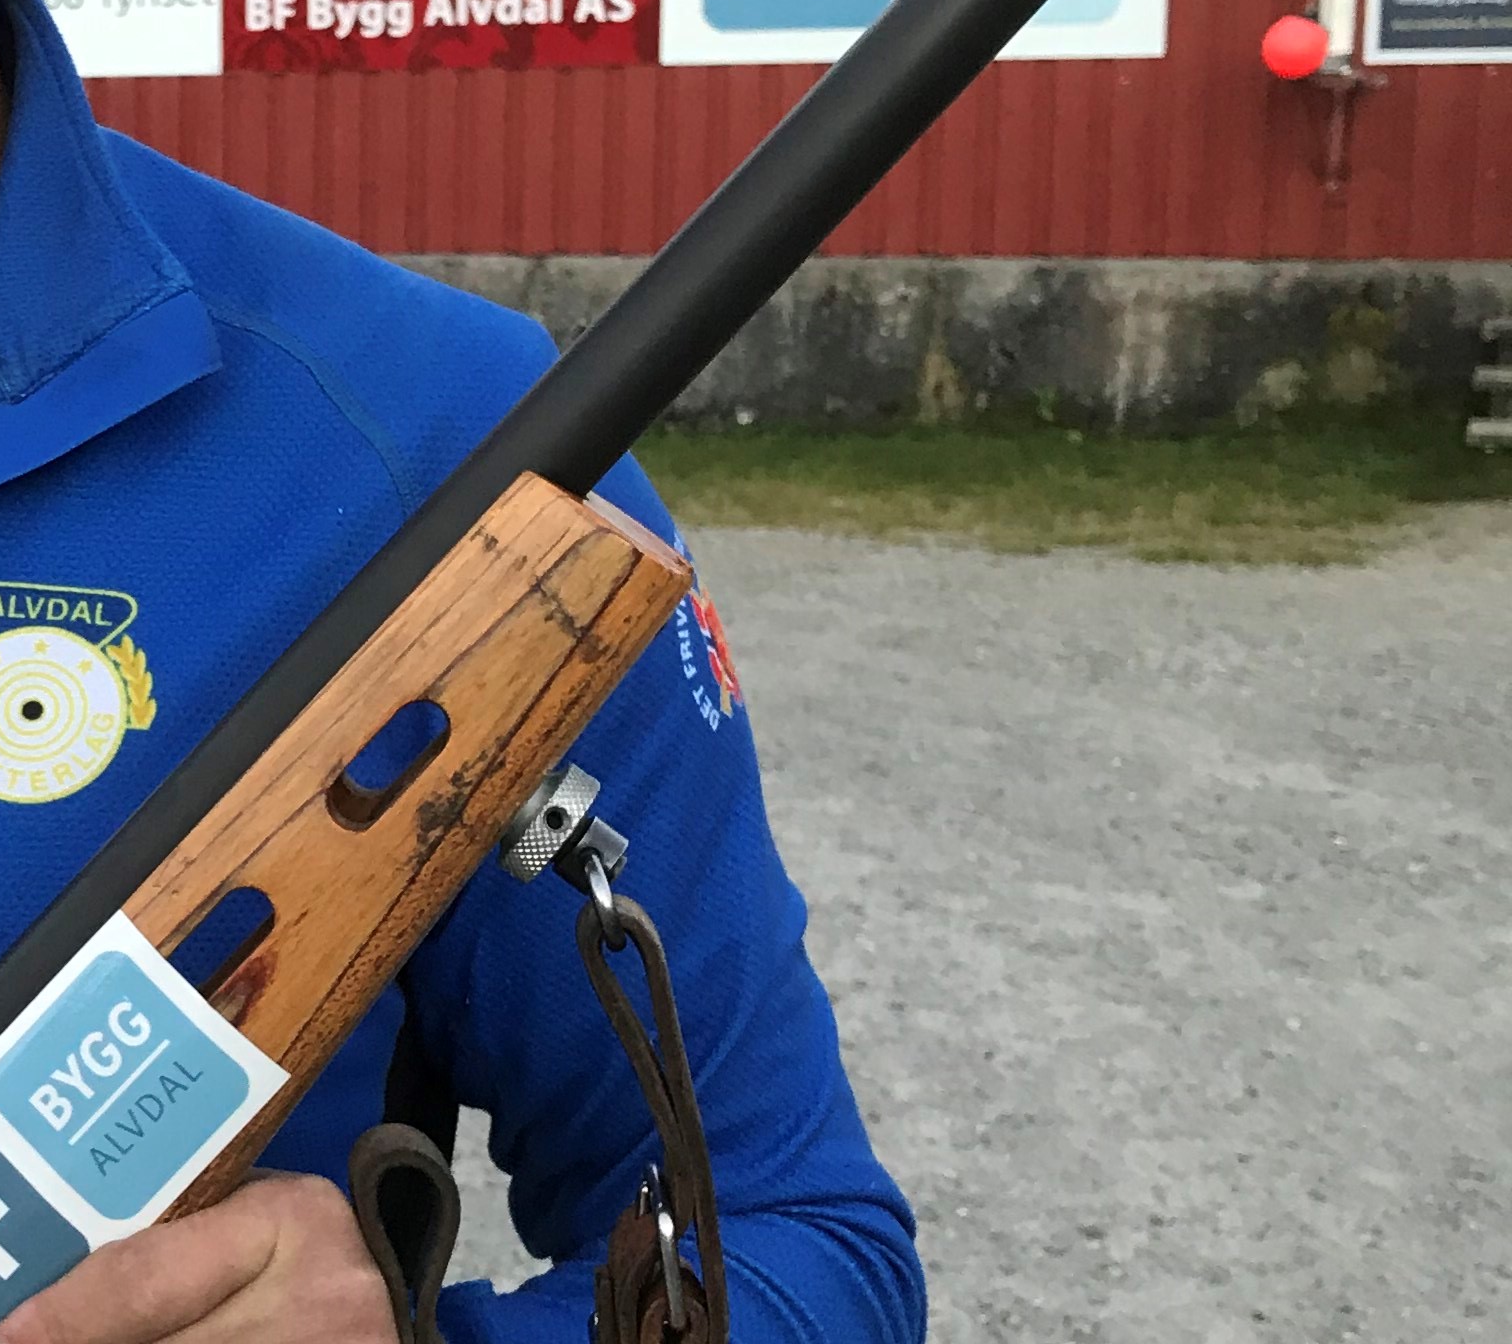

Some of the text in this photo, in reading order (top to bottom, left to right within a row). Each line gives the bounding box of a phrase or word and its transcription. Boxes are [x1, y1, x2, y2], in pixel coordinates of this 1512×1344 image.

[692, 685, 720, 732] DET
[28, 998, 153, 1132] BYGG
[87, 1060, 205, 1177] ALVDAL
